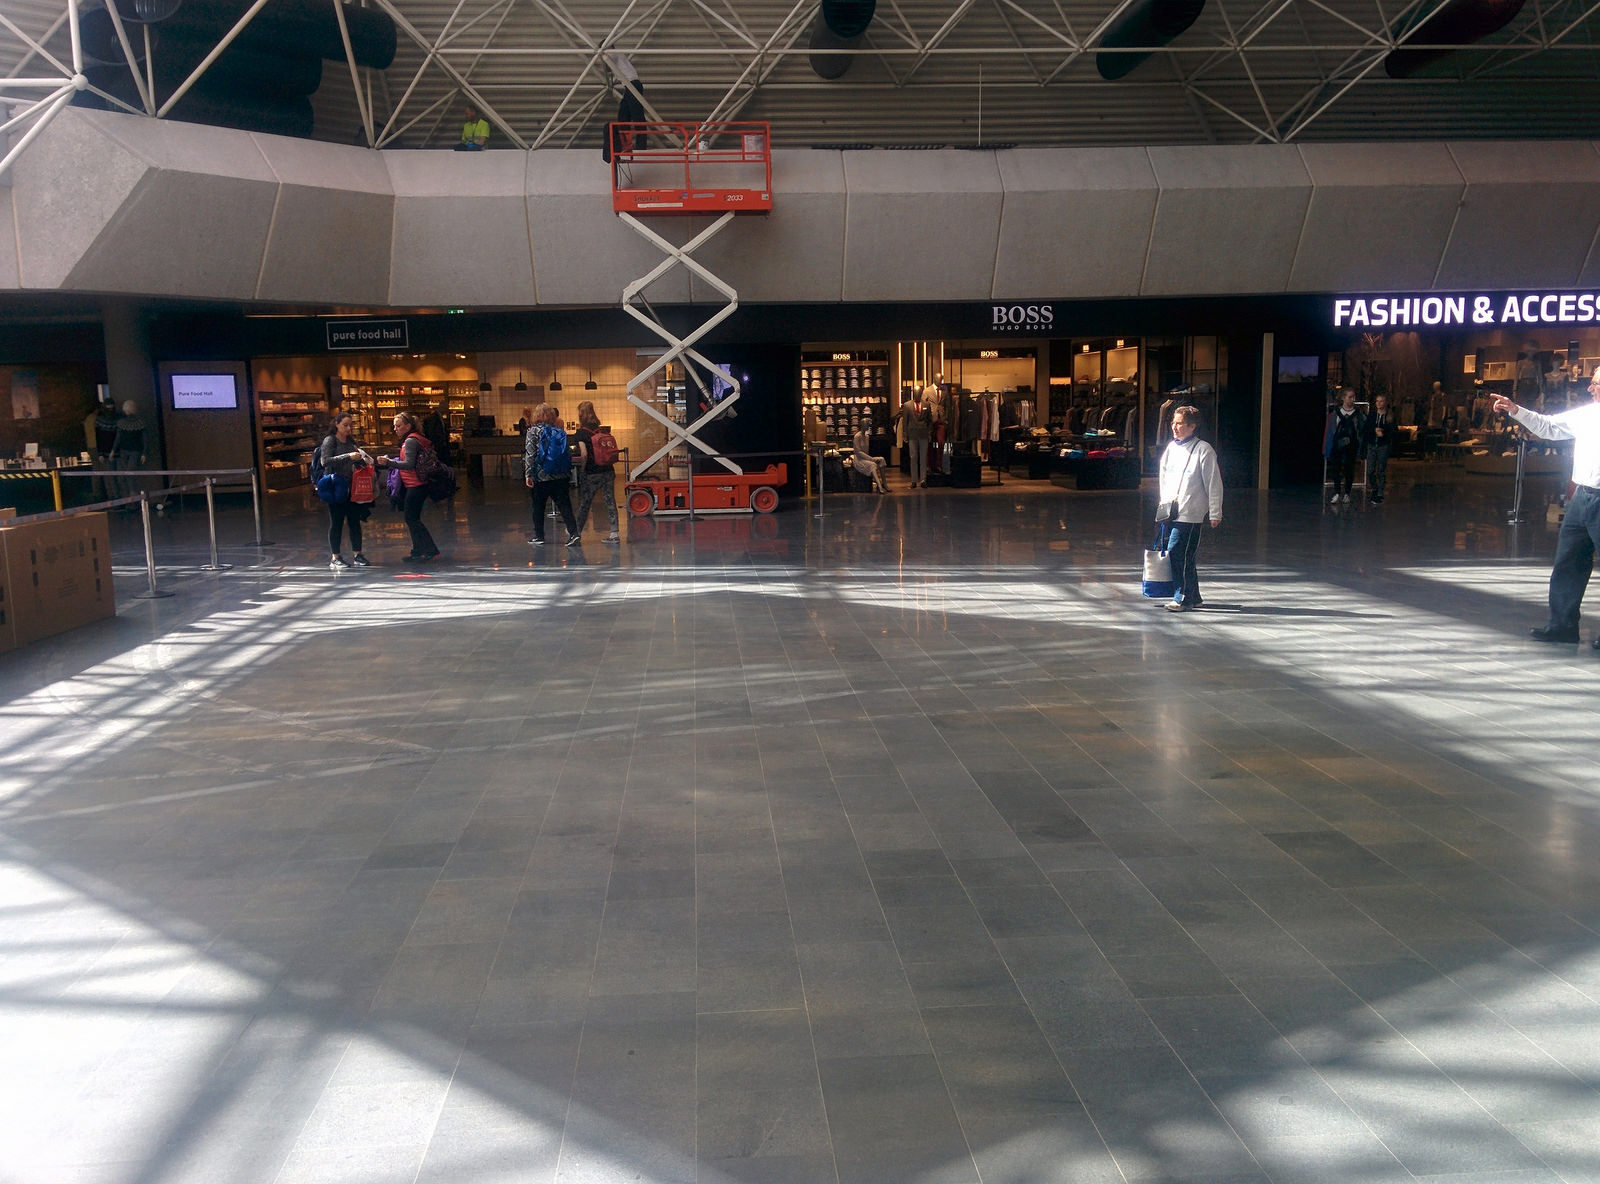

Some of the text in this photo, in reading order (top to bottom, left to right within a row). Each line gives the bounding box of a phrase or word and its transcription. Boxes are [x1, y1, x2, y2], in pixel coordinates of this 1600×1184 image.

[992, 305, 1054, 324] BOSS
[1333, 294, 1600, 327] FASHION & ACCES
[333, 328, 401, 343] pure food hall
